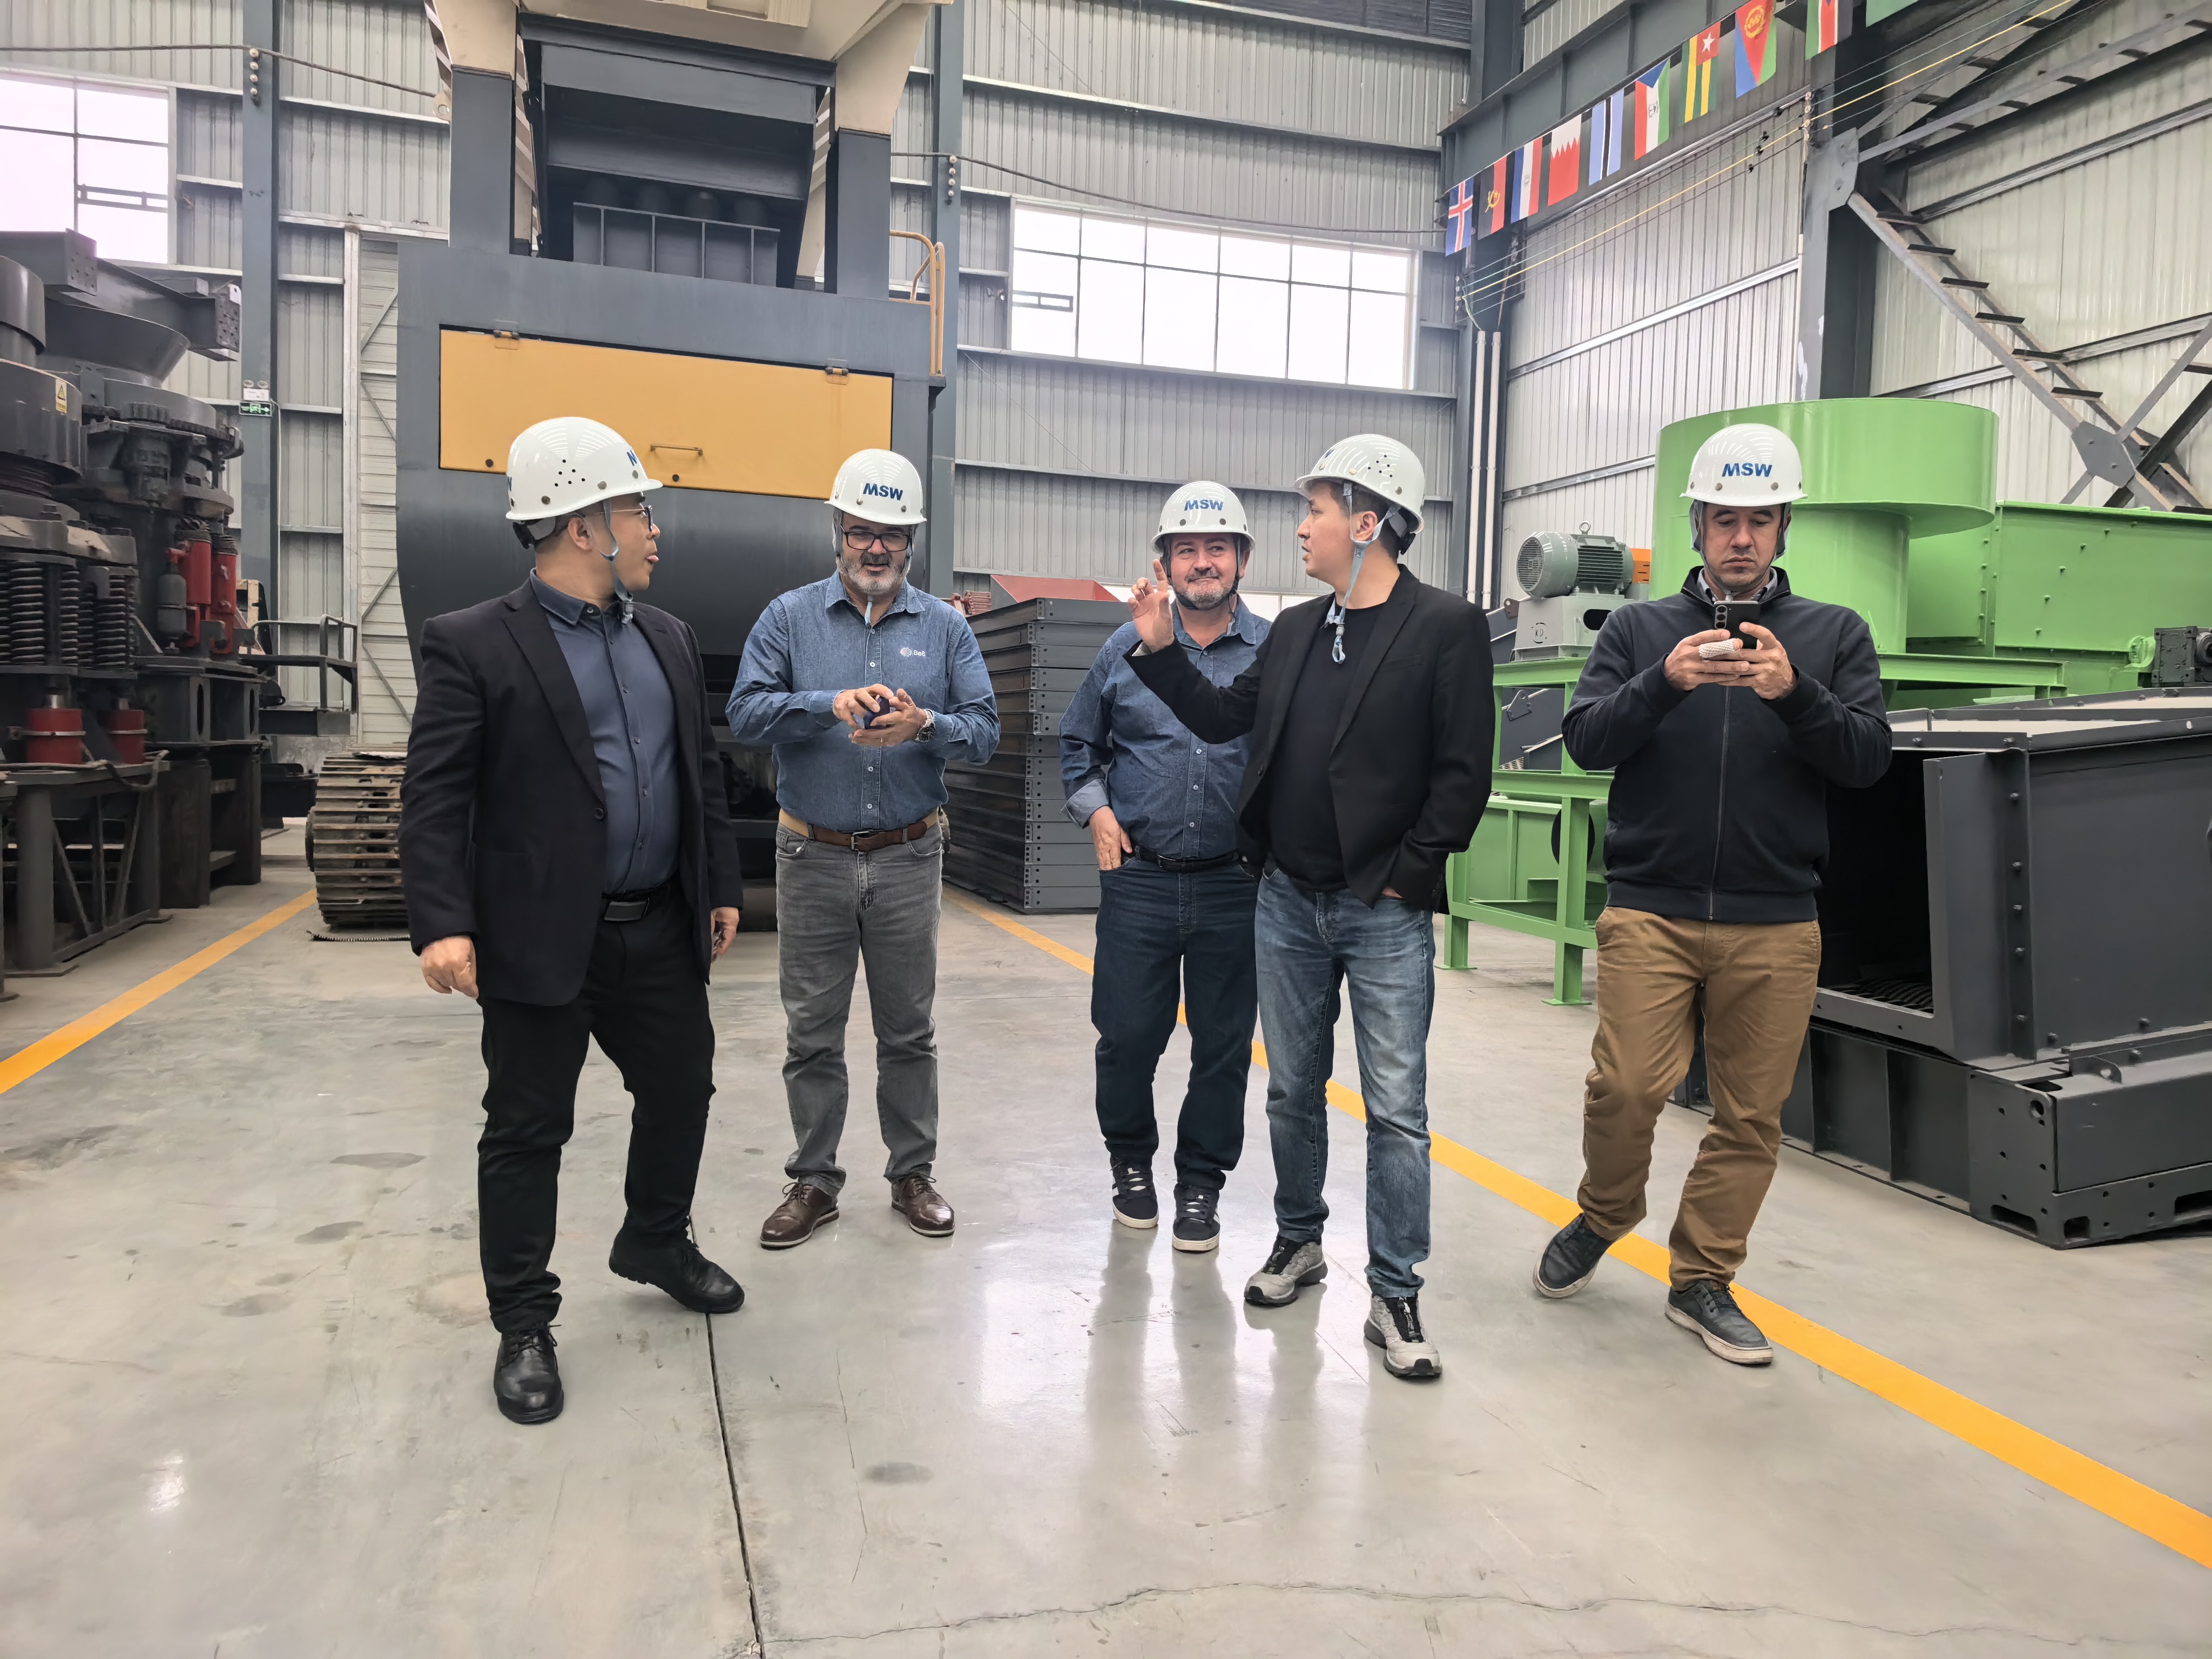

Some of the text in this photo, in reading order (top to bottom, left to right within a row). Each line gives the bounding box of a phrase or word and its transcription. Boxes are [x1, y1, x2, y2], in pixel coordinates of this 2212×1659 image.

[1721, 463, 1772, 477] MSW
[863, 483, 903, 501] MSW
[1184, 500, 1224, 511] MSW
